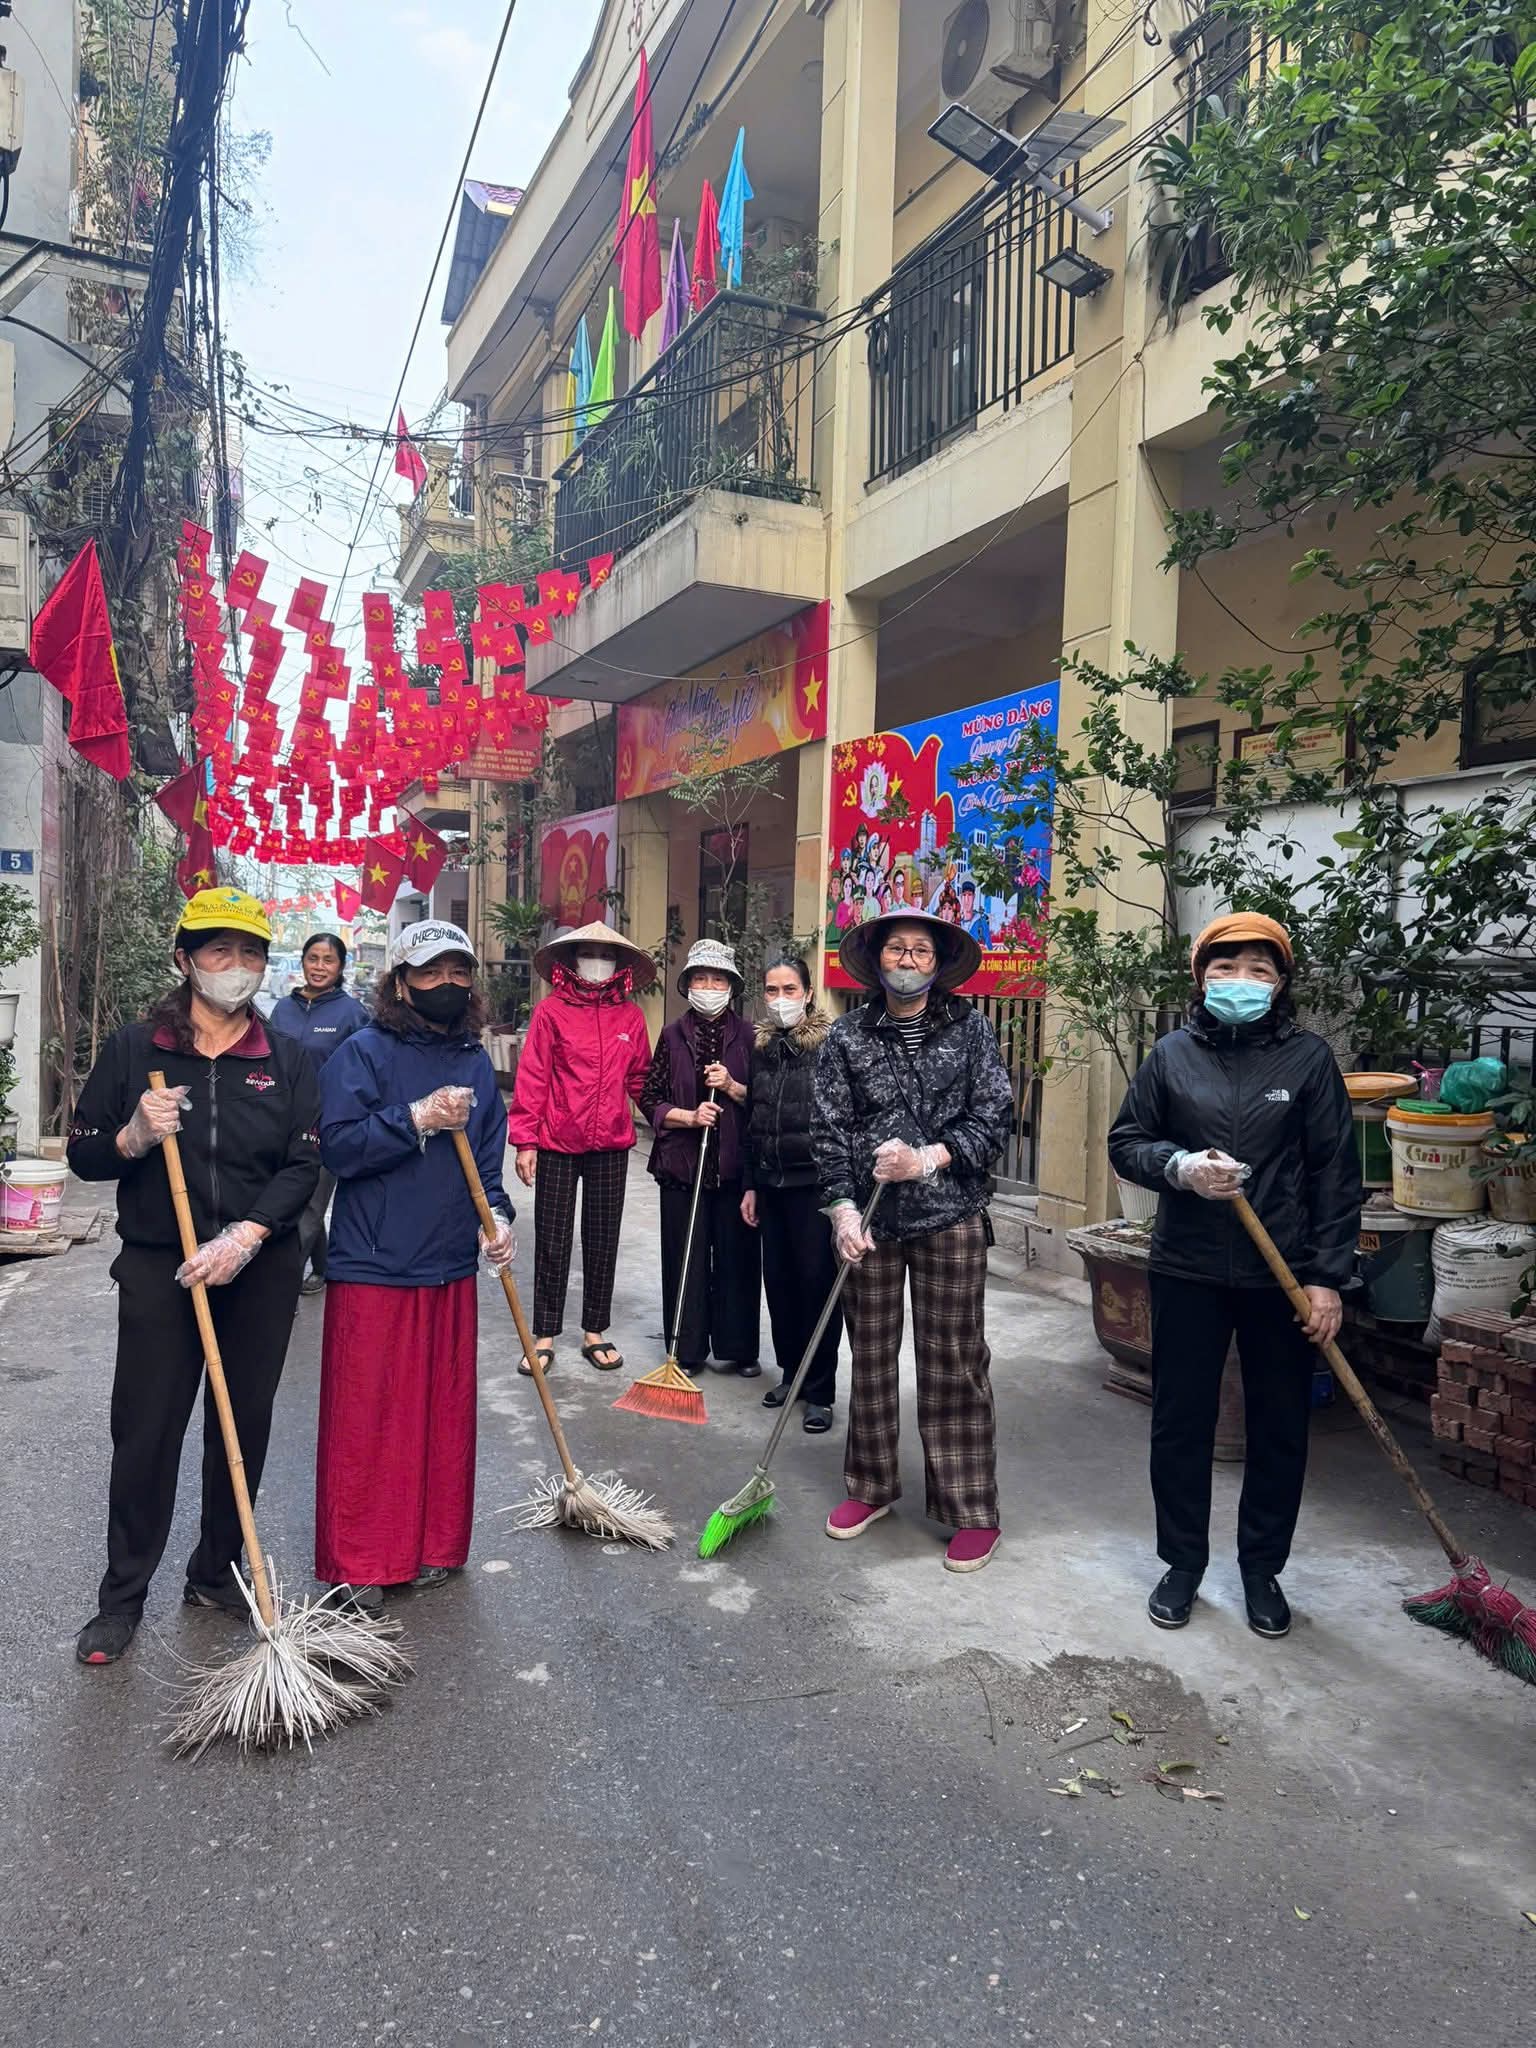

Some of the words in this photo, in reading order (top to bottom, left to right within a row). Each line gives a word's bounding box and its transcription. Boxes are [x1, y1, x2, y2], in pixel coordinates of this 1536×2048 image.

[962, 713, 1004, 738] MỪNG
[1007, 699, 1052, 726] ĐẢNG
[11, 853, 21, 869] 5
